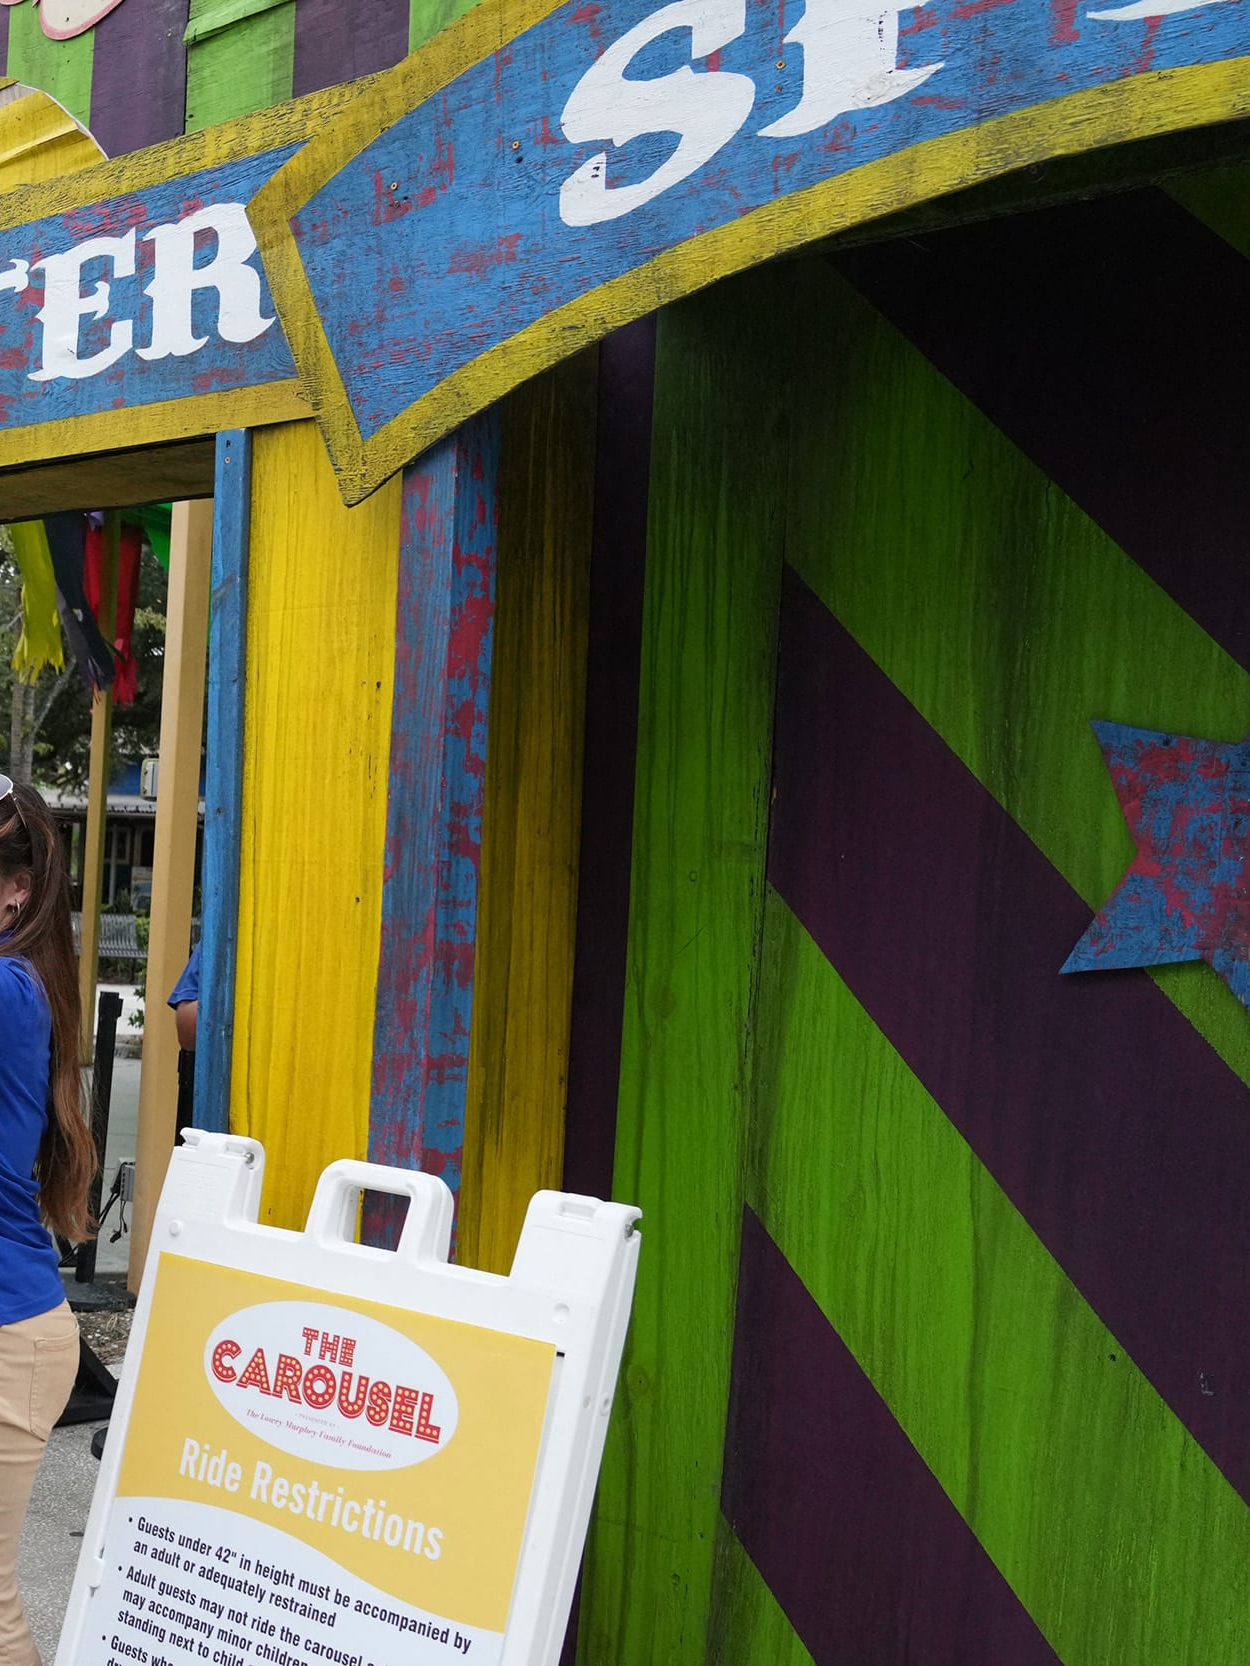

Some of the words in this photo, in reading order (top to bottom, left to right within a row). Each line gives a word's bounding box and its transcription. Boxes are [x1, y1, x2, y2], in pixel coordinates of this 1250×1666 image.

[302, 1326, 357, 1368] THE
[211, 1339, 442, 1445] CAROUSEL
[318, 1428, 347, 1447] Family
[347, 1439, 392, 1459] Foundation
[178, 1437, 244, 1493] Ride
[249, 1460, 446, 1561] Restrictions
[122, 1589, 146, 1610] may
[148, 1600, 214, 1638] accompany
[217, 1627, 252, 1651] minor
[126, 1565, 157, 1590] Adult
[158, 1580, 197, 1606] guests
[199, 1597, 225, 1619] may
[227, 1608, 248, 1626] not
[251, 1616, 276, 1637] ride
[280, 1626, 300, 1646] the
[304, 1639, 363, 1666] carousel
[133, 1540, 148, 1555] an
[151, 1546, 180, 1568] adult
[183, 1559, 195, 1573] or
[198, 1565, 266, 1604] adequately
[269, 1592, 336, 1628] restrained
[137, 1516, 175, 1543] Guests
[178, 1534, 212, 1556] under
[239, 1554, 251, 1572] in
[254, 1559, 295, 1588] height
[298, 1578, 331, 1601] must
[334, 1588, 350, 1608] be
[354, 1599, 450, 1644] accompanied
[454, 1631, 472, 1655] by
[111, 1635, 148, 1663] Guests
[117, 1610, 166, 1643] standing
[169, 1632, 195, 1652] next
[197, 1641, 209, 1658] to
[213, 1650, 244, 1666] child
